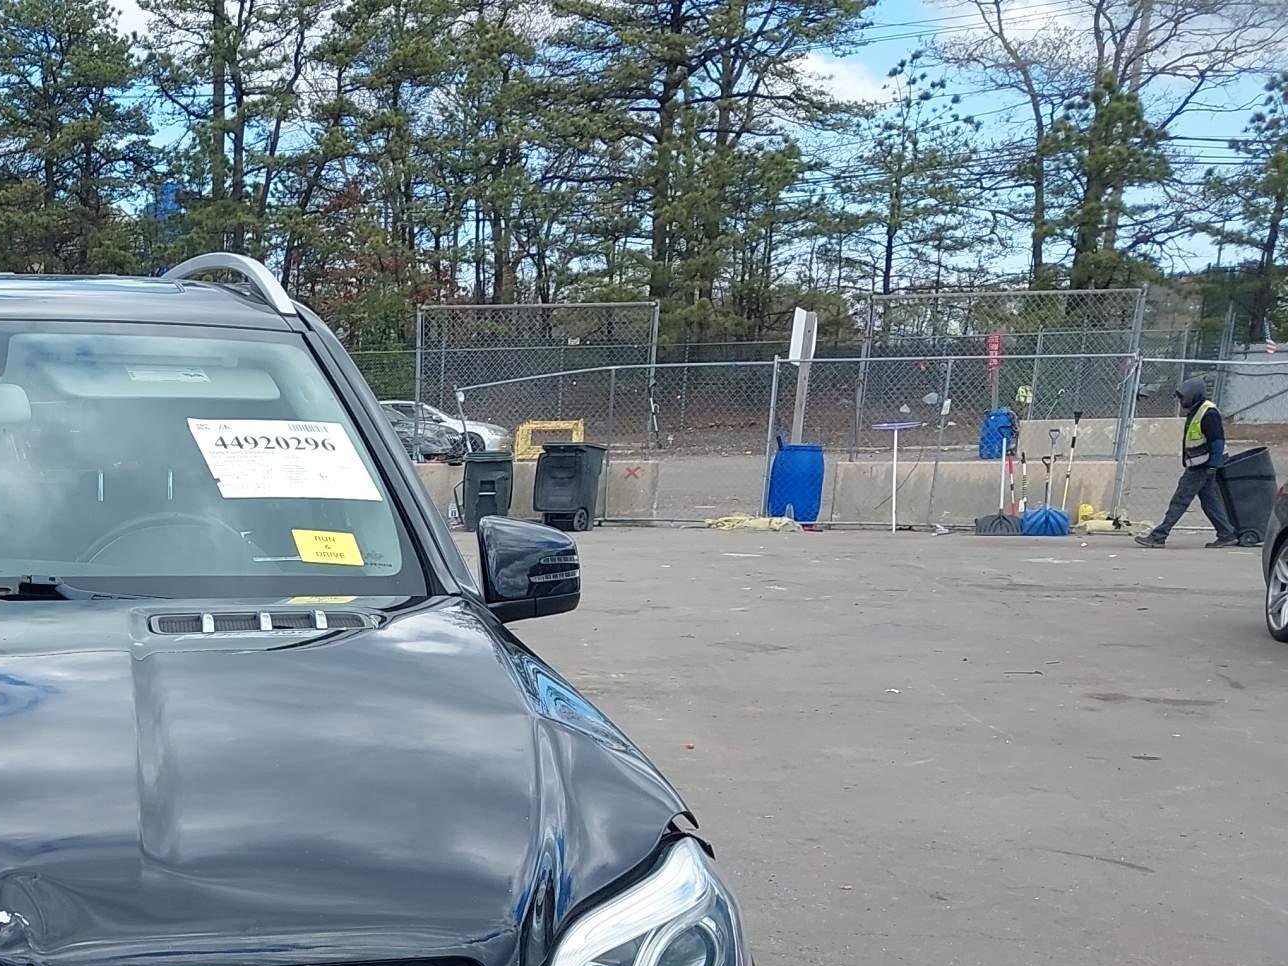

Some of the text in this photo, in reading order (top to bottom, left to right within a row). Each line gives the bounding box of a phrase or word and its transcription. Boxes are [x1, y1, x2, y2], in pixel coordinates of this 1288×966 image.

[214, 435, 336, 451] 44920296
[314, 535, 336, 543] RUN
[315, 551, 346, 559] DRIVE
